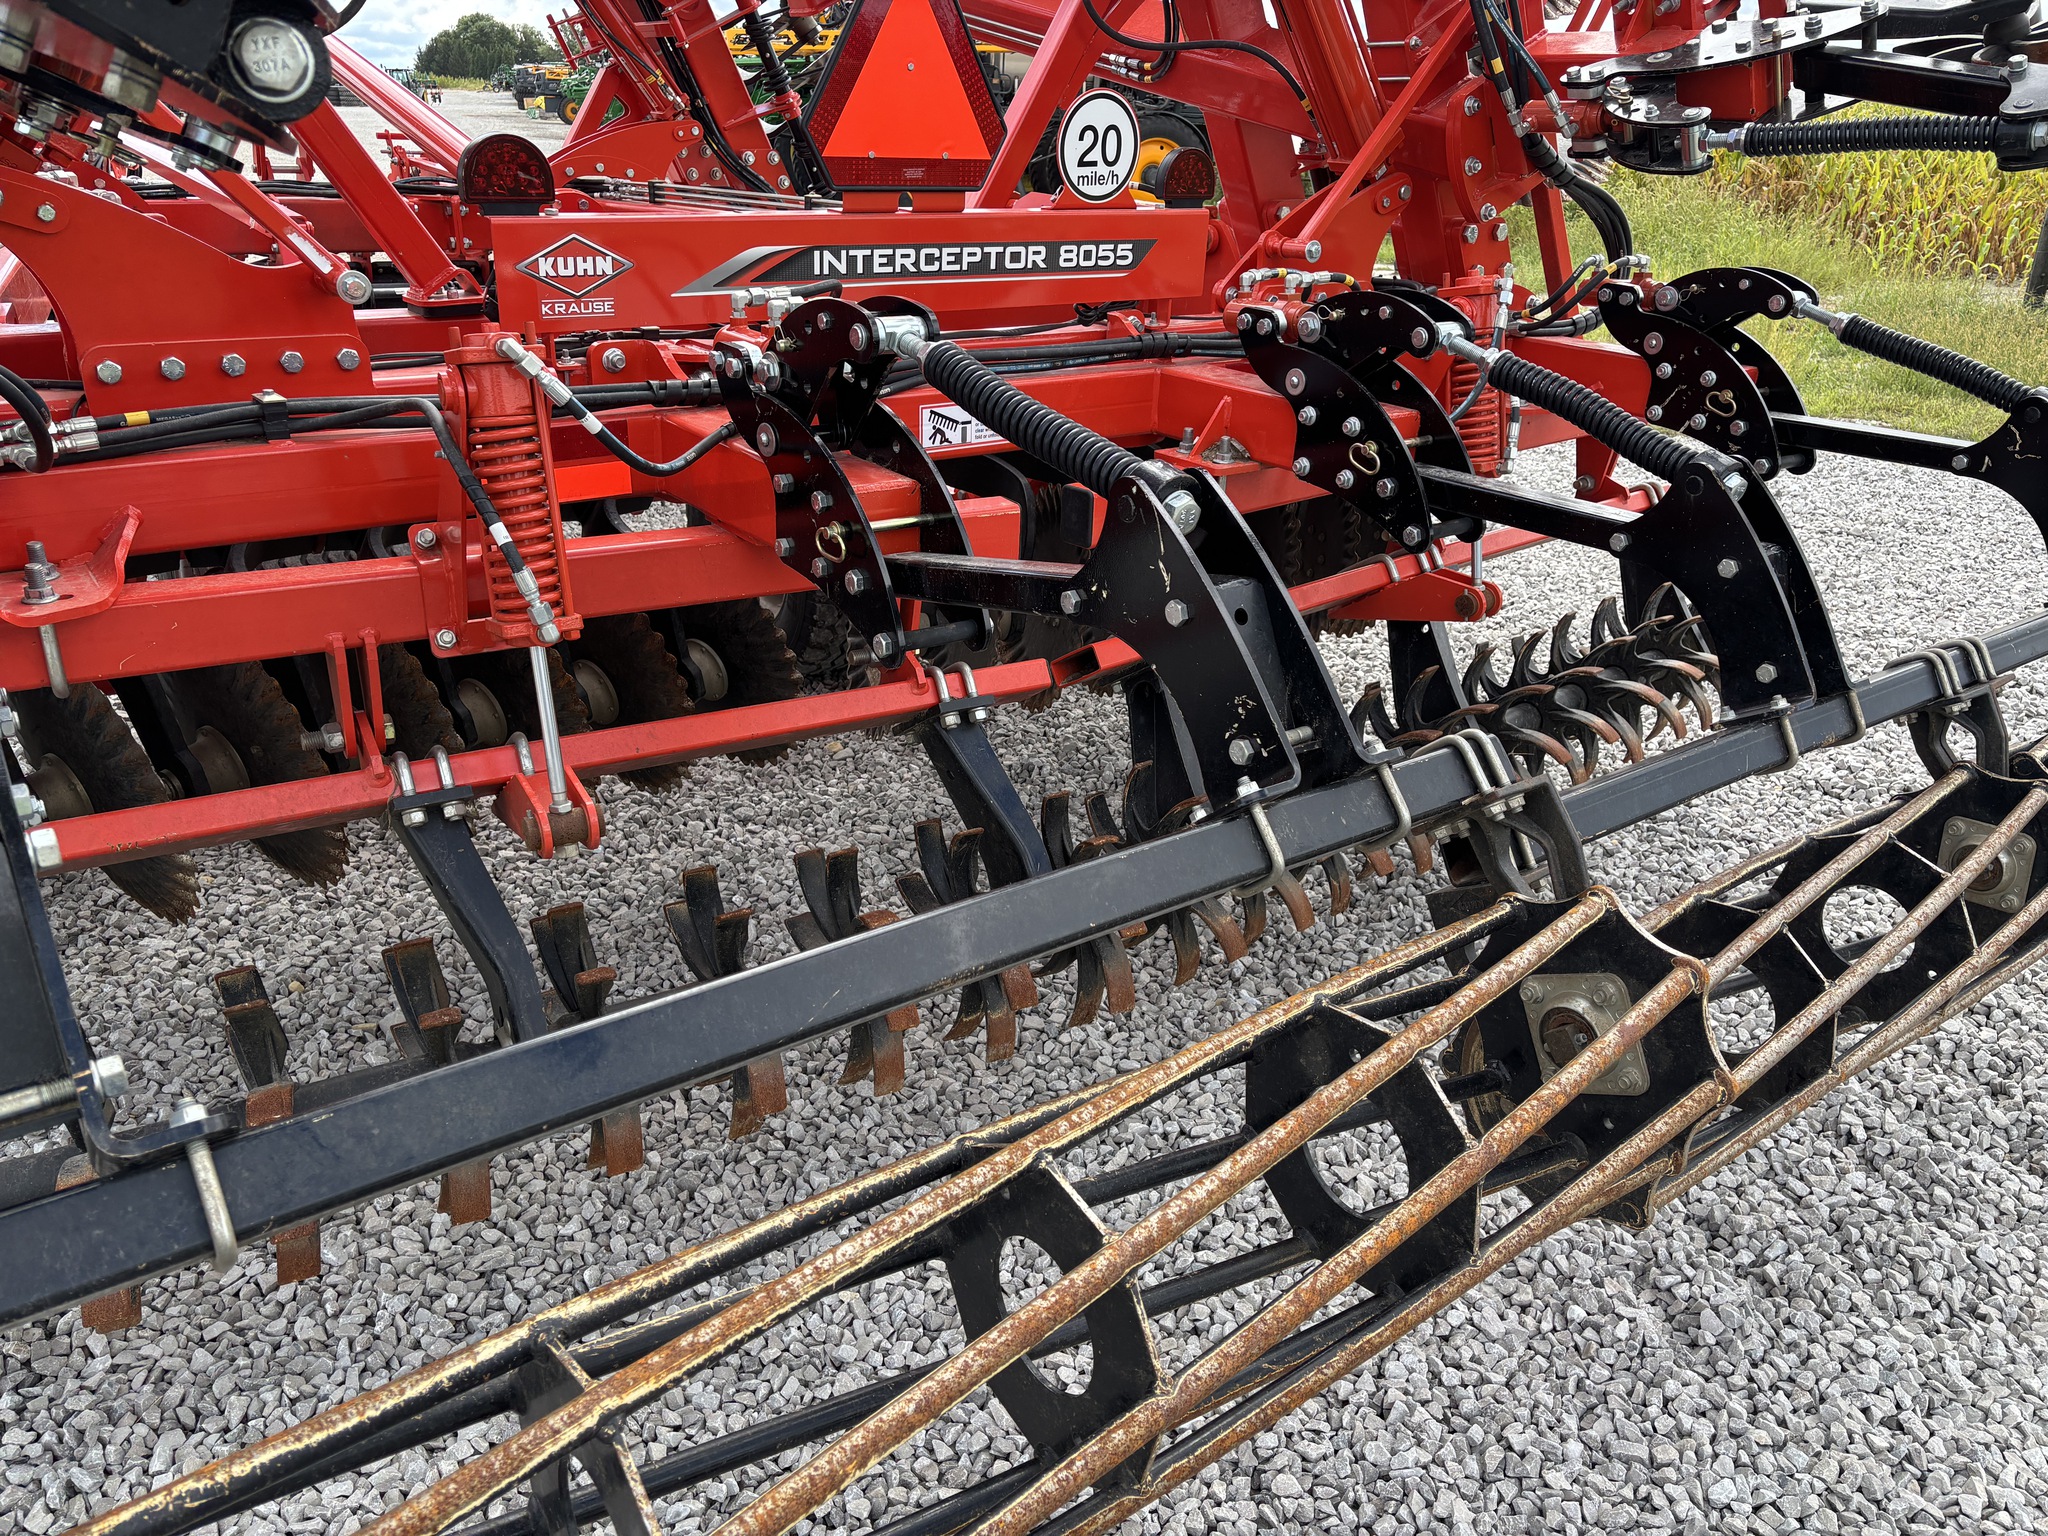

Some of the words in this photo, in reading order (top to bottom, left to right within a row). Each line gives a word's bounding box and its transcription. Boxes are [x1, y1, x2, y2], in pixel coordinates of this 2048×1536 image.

[251, 36, 279, 51] YXF
[252, 58, 291, 73] 307A
[1077, 124, 1122, 167] 20
[1077, 170, 1119, 186] mile/h
[538, 256, 614, 277] KUHN
[813, 246, 1047, 275] INTERCEPTOR
[1059, 244, 1133, 268] 8055
[541, 301, 615, 315] KRAUSE
